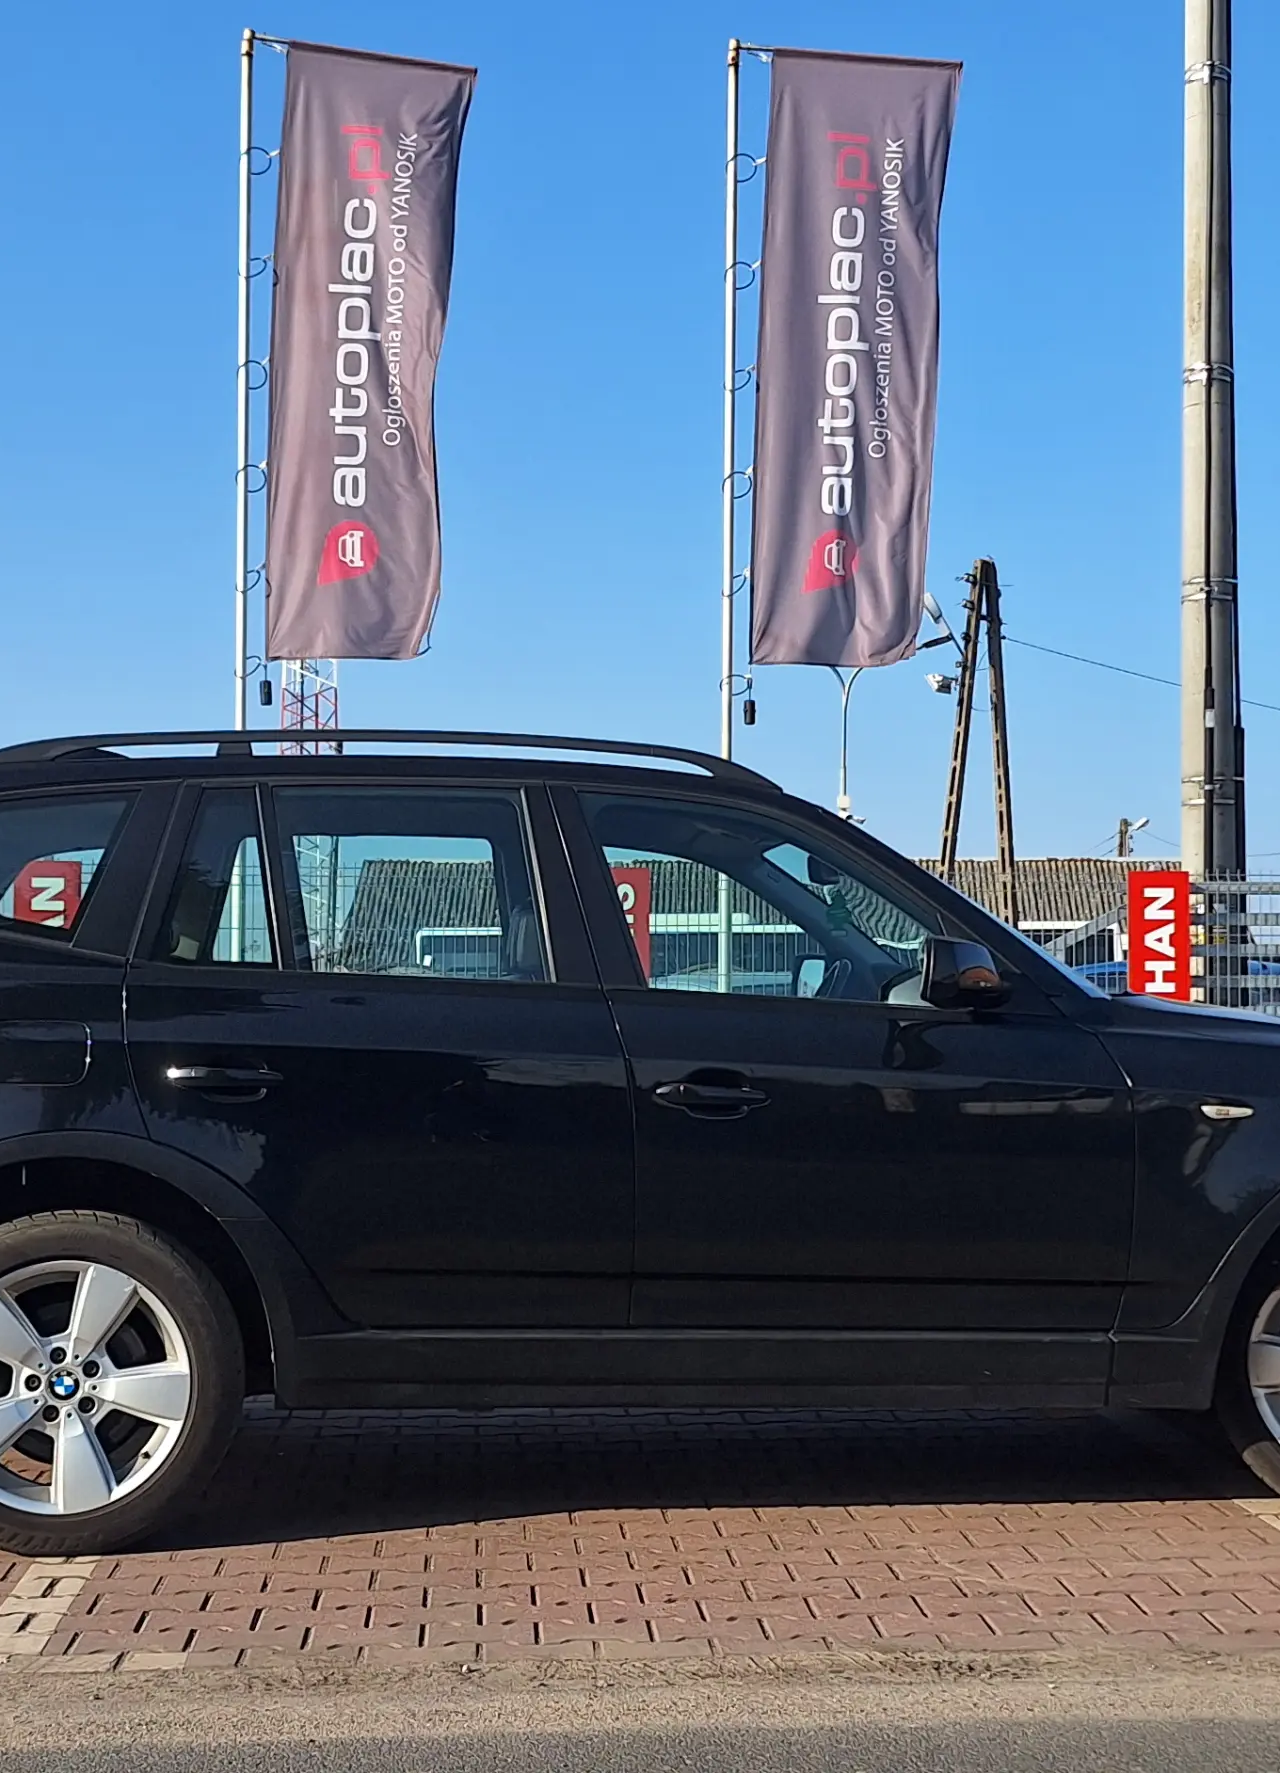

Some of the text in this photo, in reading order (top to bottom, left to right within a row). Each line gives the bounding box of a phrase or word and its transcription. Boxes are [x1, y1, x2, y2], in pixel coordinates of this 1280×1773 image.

[391, 132, 418, 220] YANOSIK
[386, 257, 407, 326] MOTO
[389, 224, 408, 253] od
[328, 124, 391, 508] autoplac.pl
[817, 131, 878, 517] autoplac.pl
[868, 137, 905, 459] Ogłoszenia MOTO od YANOSIK
[1143, 886, 1176, 994] HAN
